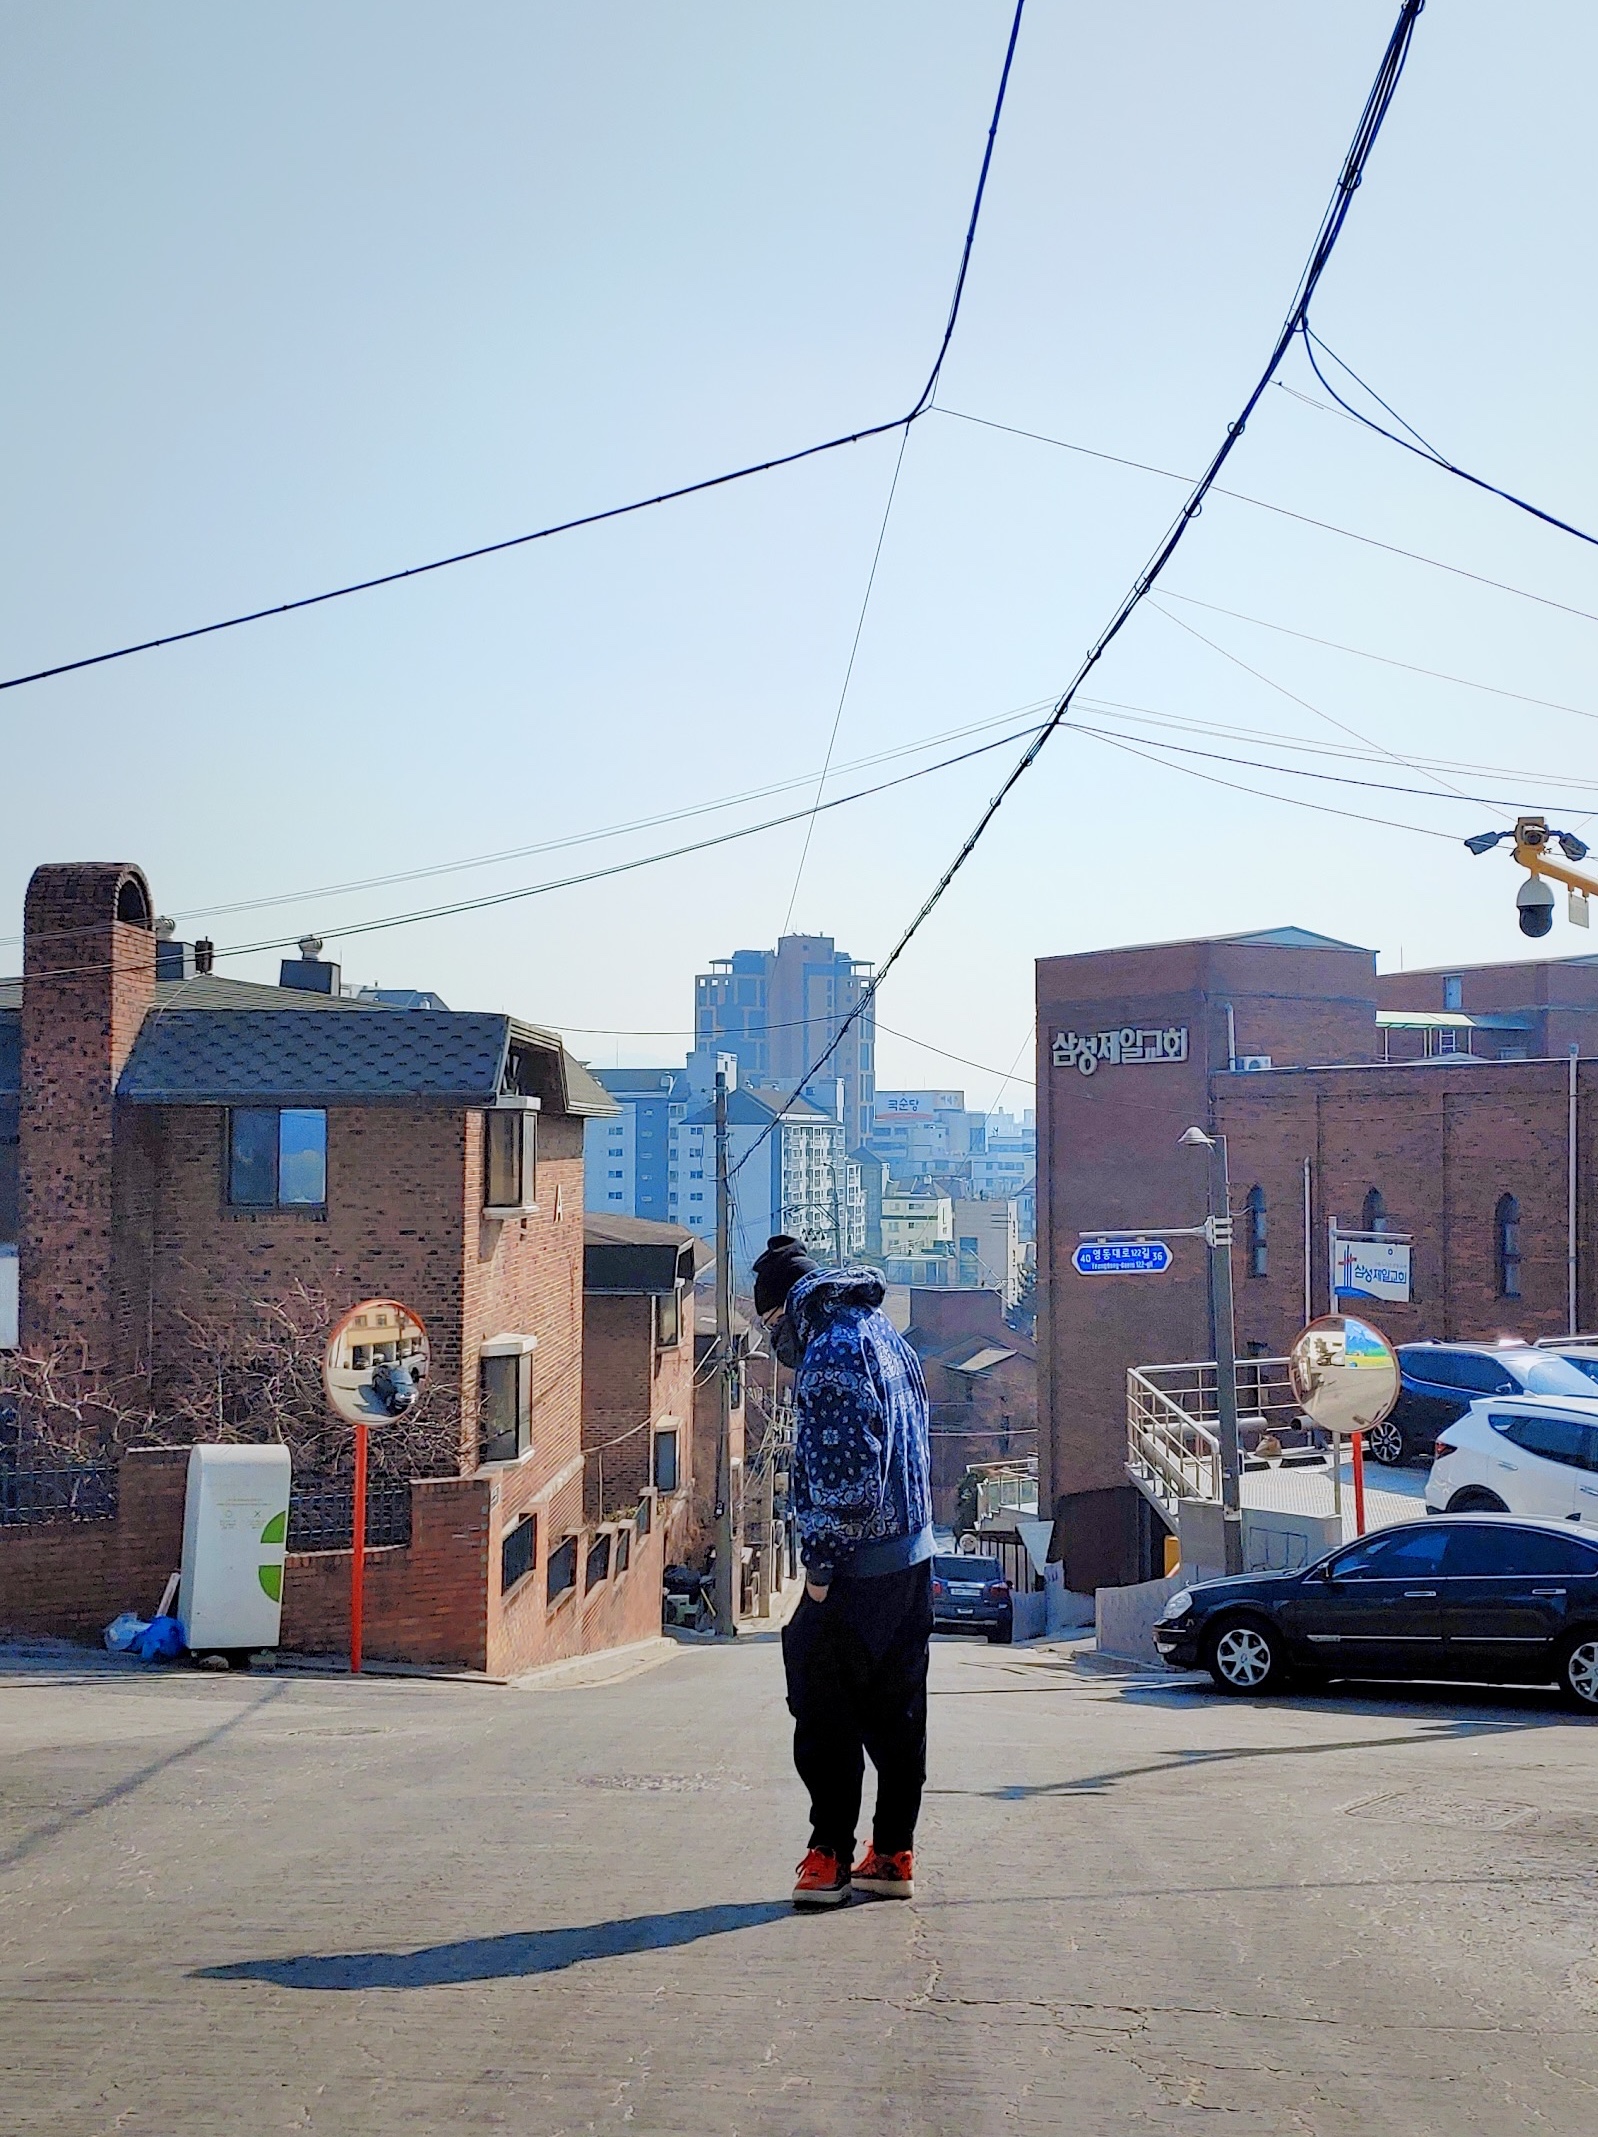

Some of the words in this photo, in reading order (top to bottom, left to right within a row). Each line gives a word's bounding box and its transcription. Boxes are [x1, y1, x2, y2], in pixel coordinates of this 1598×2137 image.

[1052, 1027, 1188, 1076] 삼성제일교회
[1080, 1254, 1091, 1263] 40
[1152, 1251, 1163, 1261] 36
[1355, 1264, 1407, 1284] 삼성제일교회
